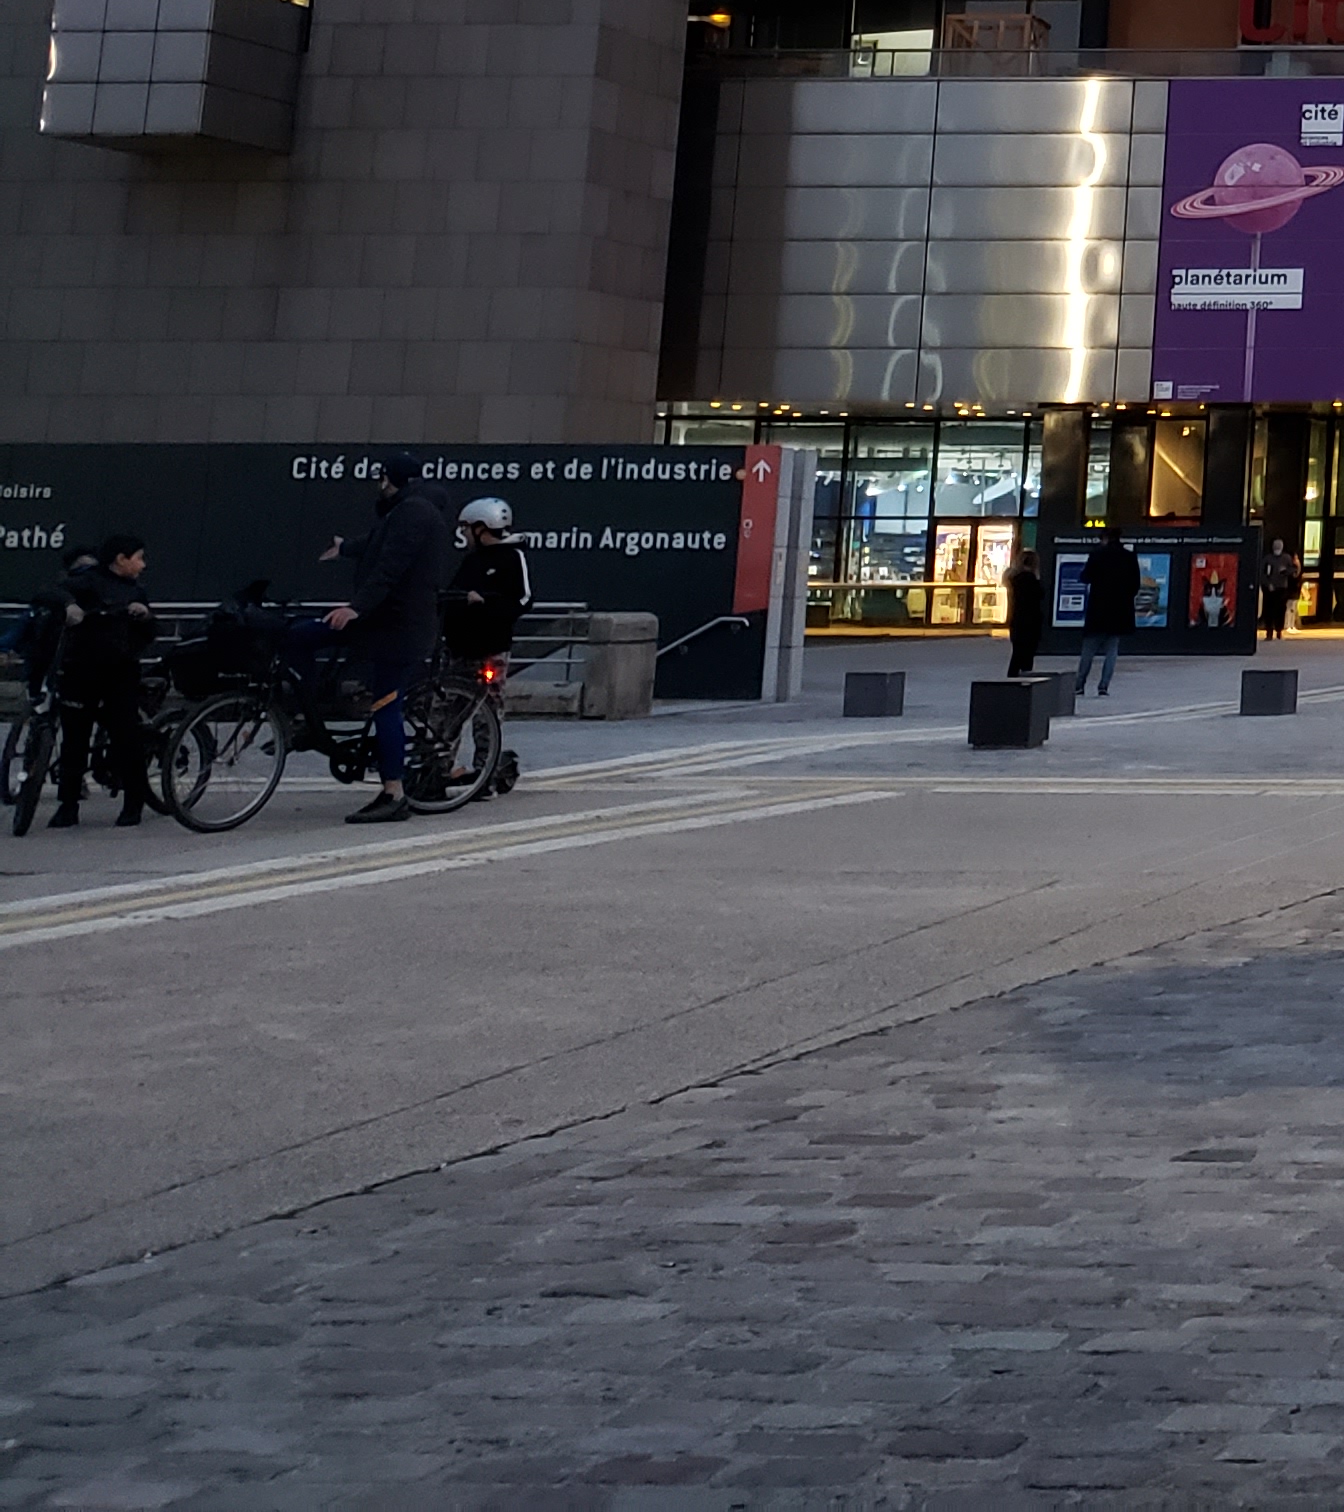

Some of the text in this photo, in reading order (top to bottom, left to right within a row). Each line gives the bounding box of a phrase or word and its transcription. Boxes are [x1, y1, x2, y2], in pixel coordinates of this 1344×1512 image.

[1302, 103, 1339, 121] cité
[1172, 268, 1288, 289] planétarium
[1172, 299, 1274, 310] haute définition 360°
[291, 455, 732, 481] Cité de ciences et de l'industrie
[599, 526, 727, 556] Argonaute
